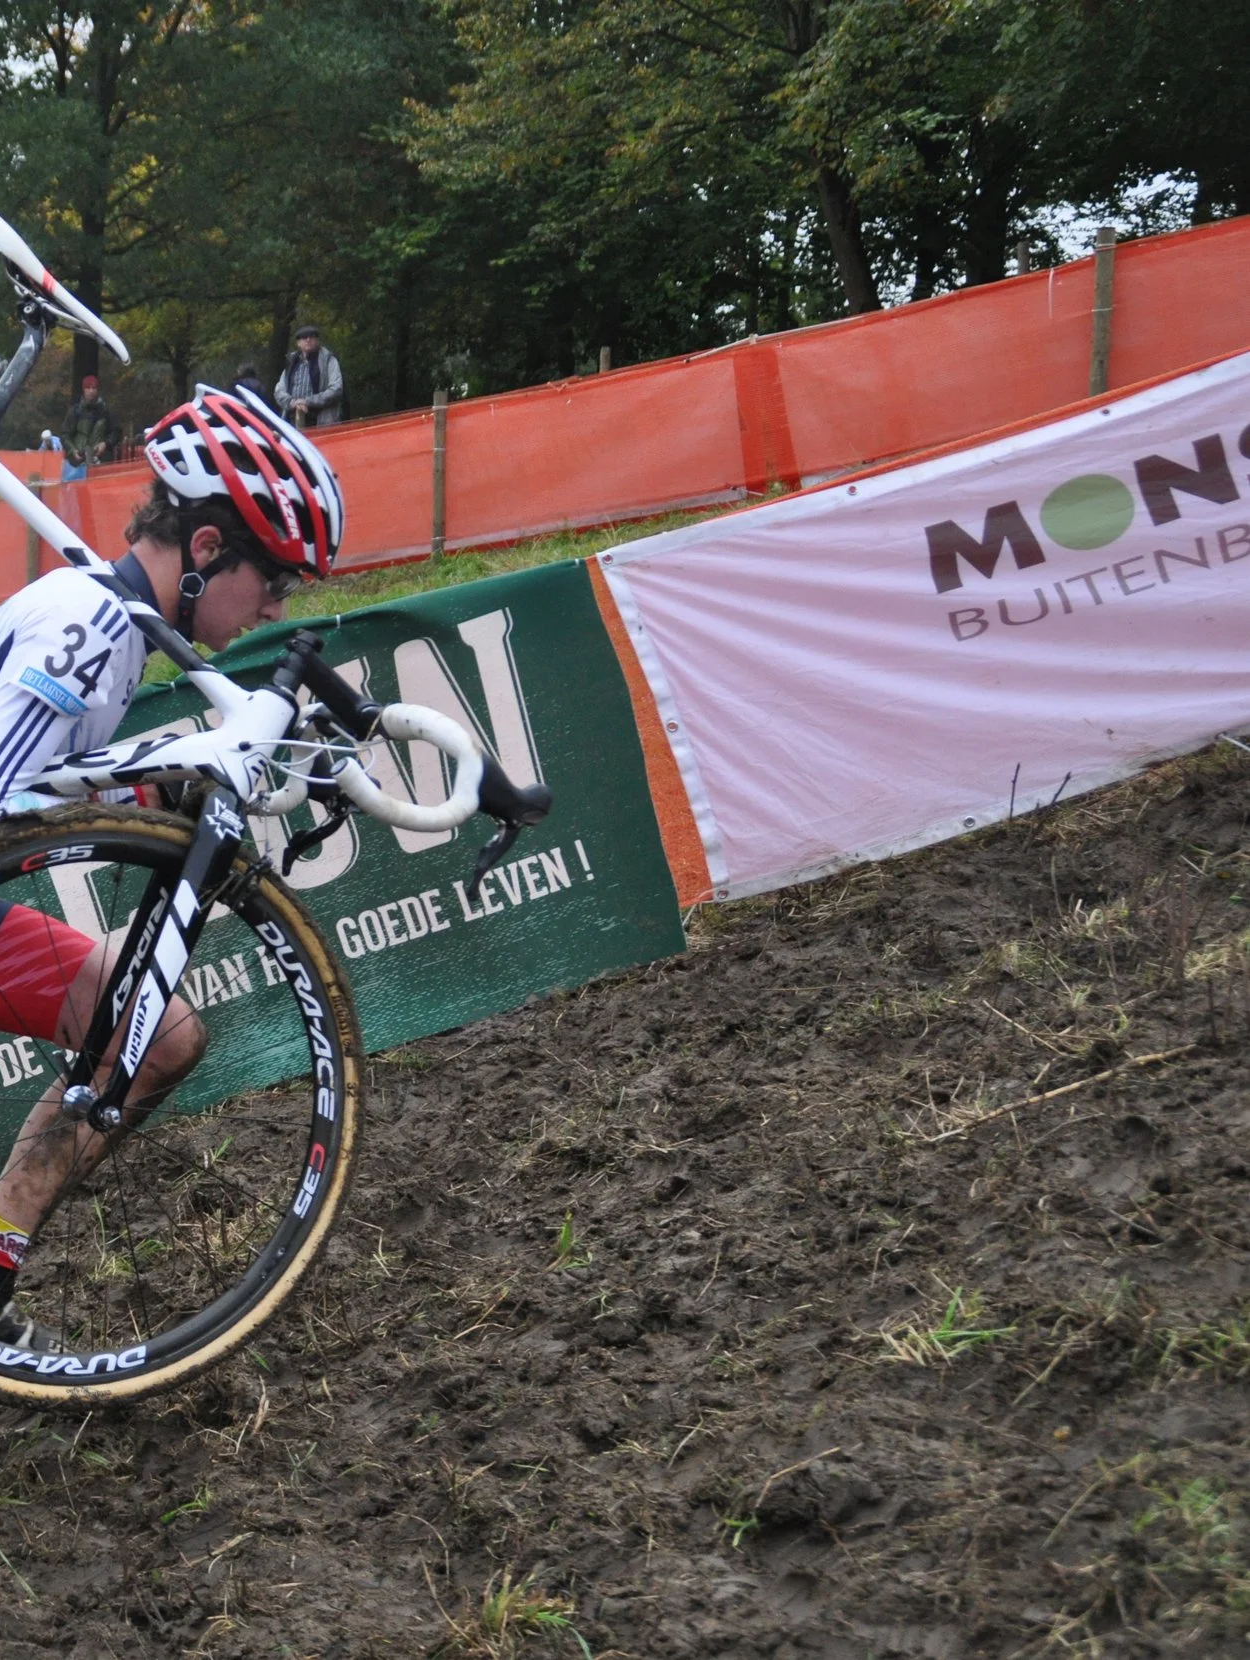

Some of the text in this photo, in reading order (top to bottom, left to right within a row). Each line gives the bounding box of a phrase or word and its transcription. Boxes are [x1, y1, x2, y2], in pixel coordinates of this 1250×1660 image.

[149, 447, 168, 473] LAZER
[924, 424, 1250, 594] MON
[271, 481, 301, 541] LAZER
[947, 523, 1250, 642] BUITENB
[44, 623, 113, 700] 34
[21, 844, 95, 872] C35
[112, 886, 170, 1029] RIDLEY
[180, 953, 252, 1012] VAN
[335, 888, 451, 959] GOEDE
[452, 846, 572, 922] LEVEN
[574, 839, 594, 881] !
[255, 921, 335, 1122] DURA-ACE
[292, 1142, 327, 1219] C35
